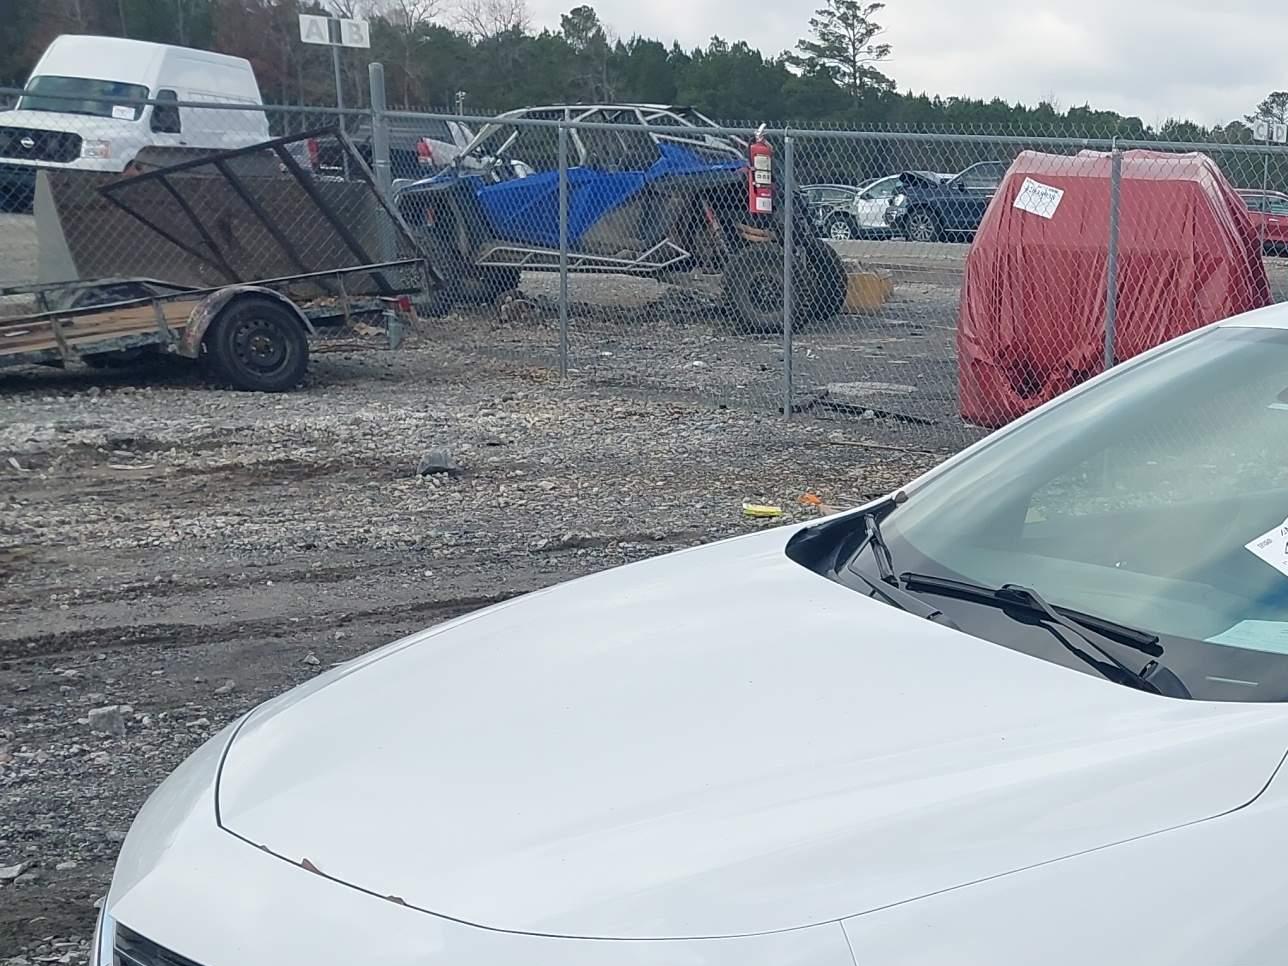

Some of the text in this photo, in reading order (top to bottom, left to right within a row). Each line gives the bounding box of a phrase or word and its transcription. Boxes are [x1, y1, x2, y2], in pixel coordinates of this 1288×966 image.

[304, 18, 364, 43] A B
[1256, 123, 1285, 140] C D
